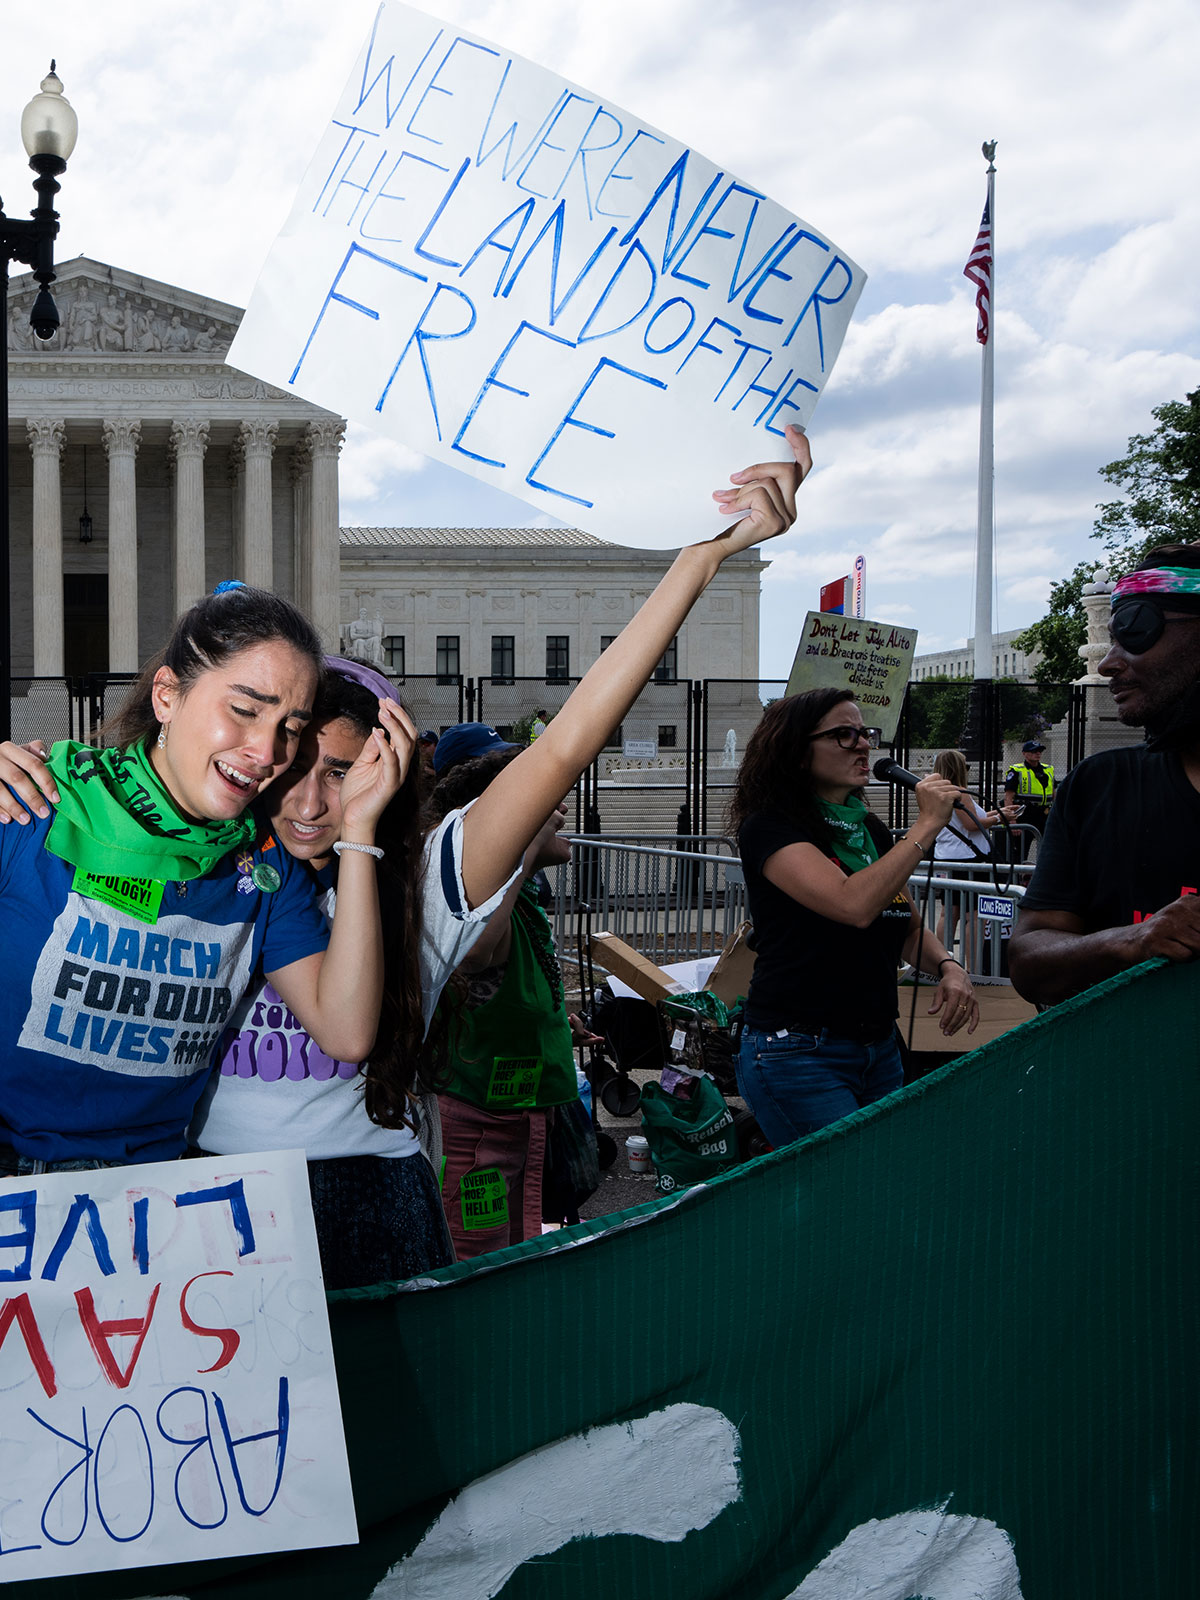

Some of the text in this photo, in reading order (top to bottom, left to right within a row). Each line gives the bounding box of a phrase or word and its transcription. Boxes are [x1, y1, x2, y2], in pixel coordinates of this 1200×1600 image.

[353, 3, 852, 372] WE WERE NEVER
[312, 119, 819, 437] THE LAND OF THE
[288, 241, 668, 508] FREE
[37, 382, 94, 395] JUSTICE
[101, 382, 148, 395] UNDER
[154, 382, 182, 395] LAW
[840, 623, 860, 642] Let
[805, 643, 821, 656] and
[869, 650, 901, 668] treatise
[844, 661, 854, 670] on
[980, 897, 1012, 916] LONG FENCE
[65, 915, 222, 979] MARCH
[53, 960, 151, 1017] FOR
[153, 983, 231, 1025] OUR
[43, 1001, 175, 1064] LIVES
[497, 1058, 538, 1070] OVERTURN
[494, 1071, 515, 1081] ROE?
[491, 1081, 535, 1096] HELL NO!
[686, 1108, 734, 1144] Reusab
[698, 1138, 728, 1156] Bag
[465, 1187, 486, 1200] ROE?
[466, 1196, 505, 1216] HELL NO!
